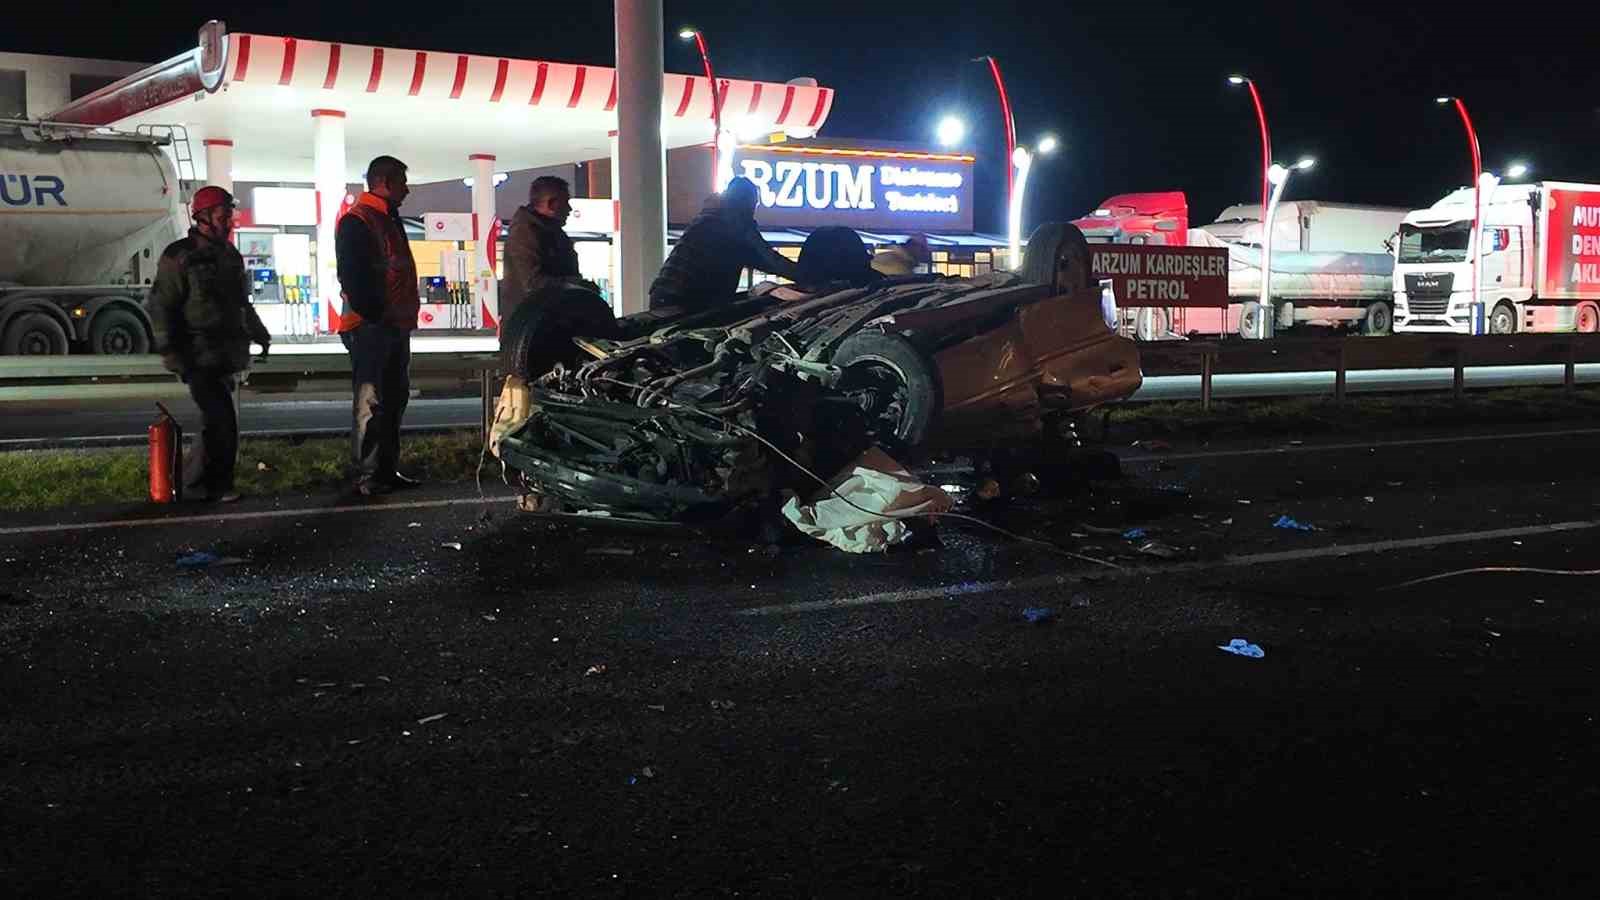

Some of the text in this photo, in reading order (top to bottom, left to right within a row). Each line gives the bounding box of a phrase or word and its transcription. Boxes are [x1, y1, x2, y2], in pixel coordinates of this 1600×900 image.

[738, 159, 876, 209] RZUM
[1092, 253, 1226, 281] ARZUM KARDEŞLER
[1127, 279, 1190, 300] PETROL
